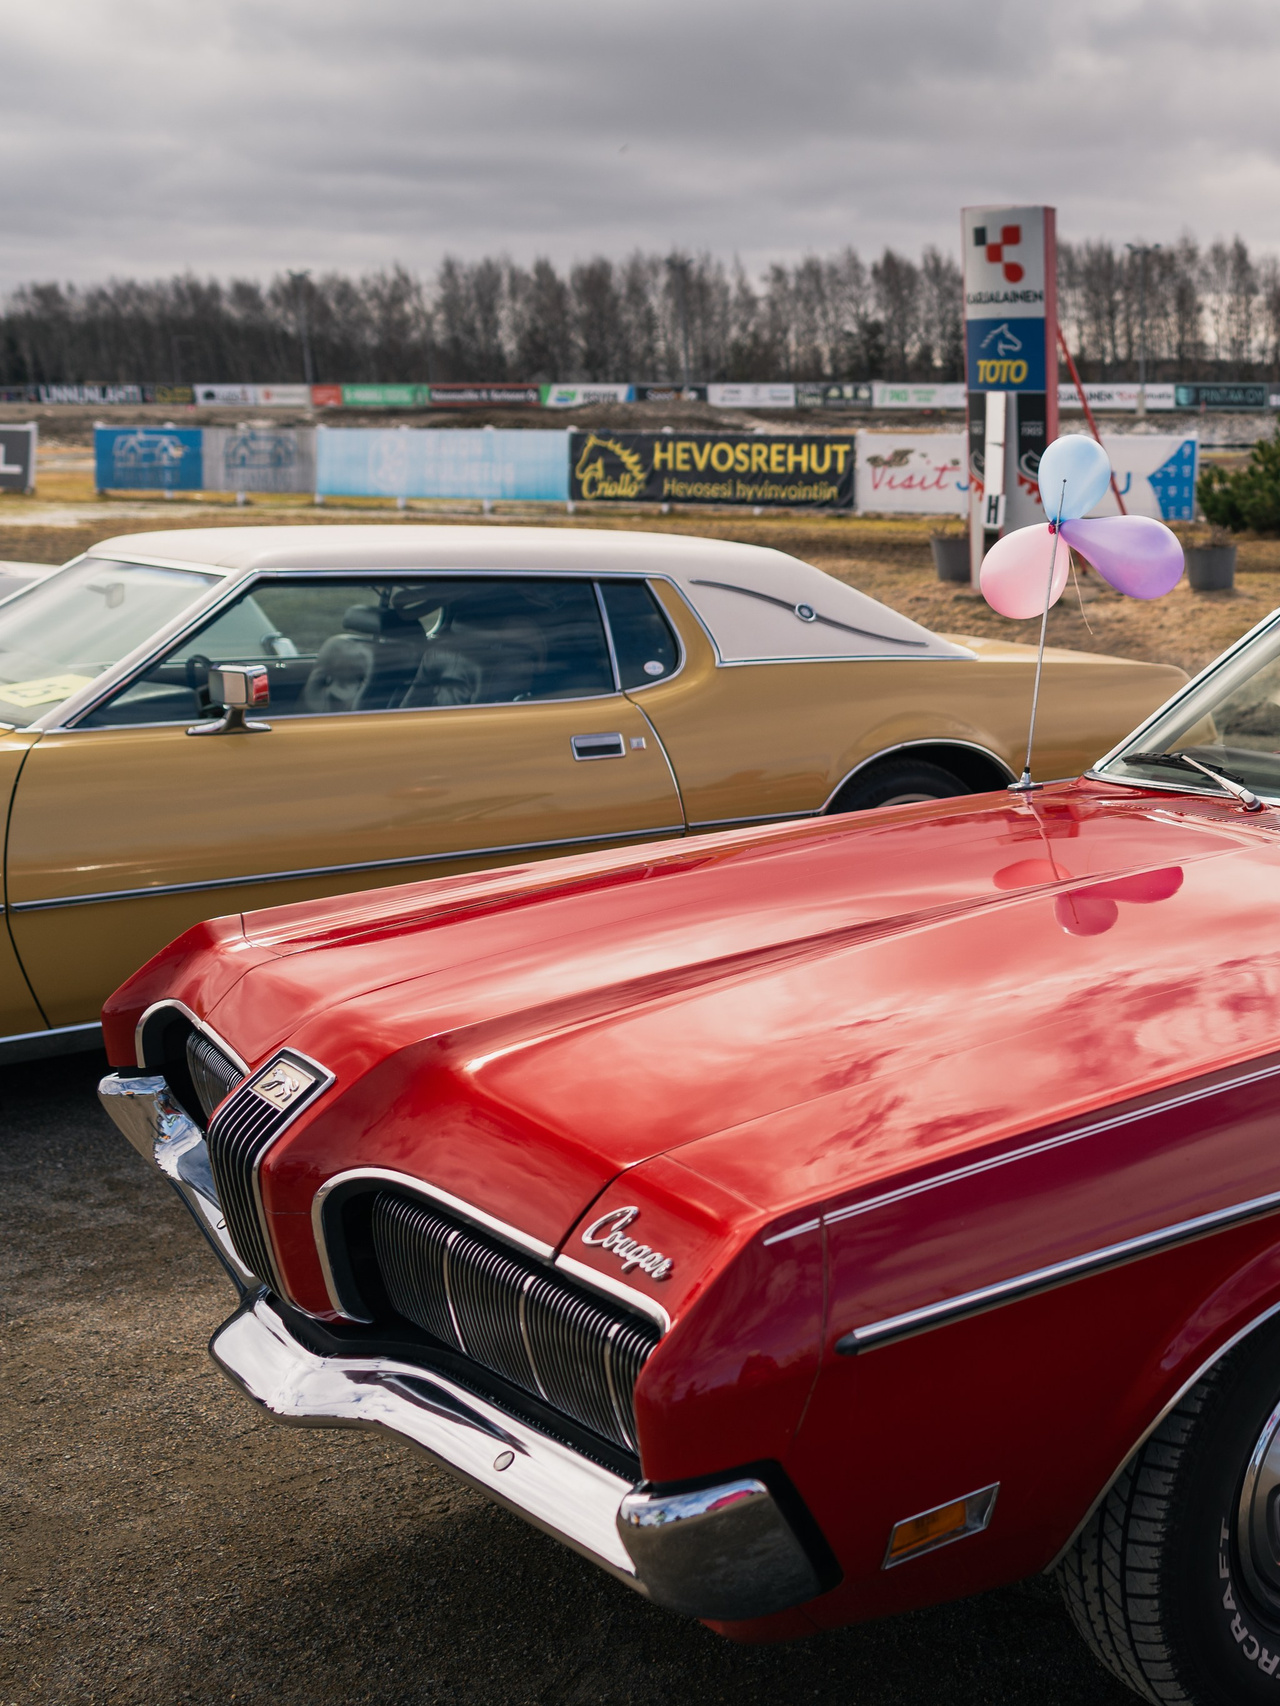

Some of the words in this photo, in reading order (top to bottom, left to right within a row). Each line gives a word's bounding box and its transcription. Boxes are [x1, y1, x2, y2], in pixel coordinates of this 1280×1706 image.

[976, 359, 1029, 384] TOTO
[653, 440, 851, 475] HEVOSREHUT
[871, 453, 961, 492] Visit
[581, 472, 640, 500] Criollo
[663, 477, 732, 498] Hevosesi
[581, 1205, 673, 1279] Cougar
